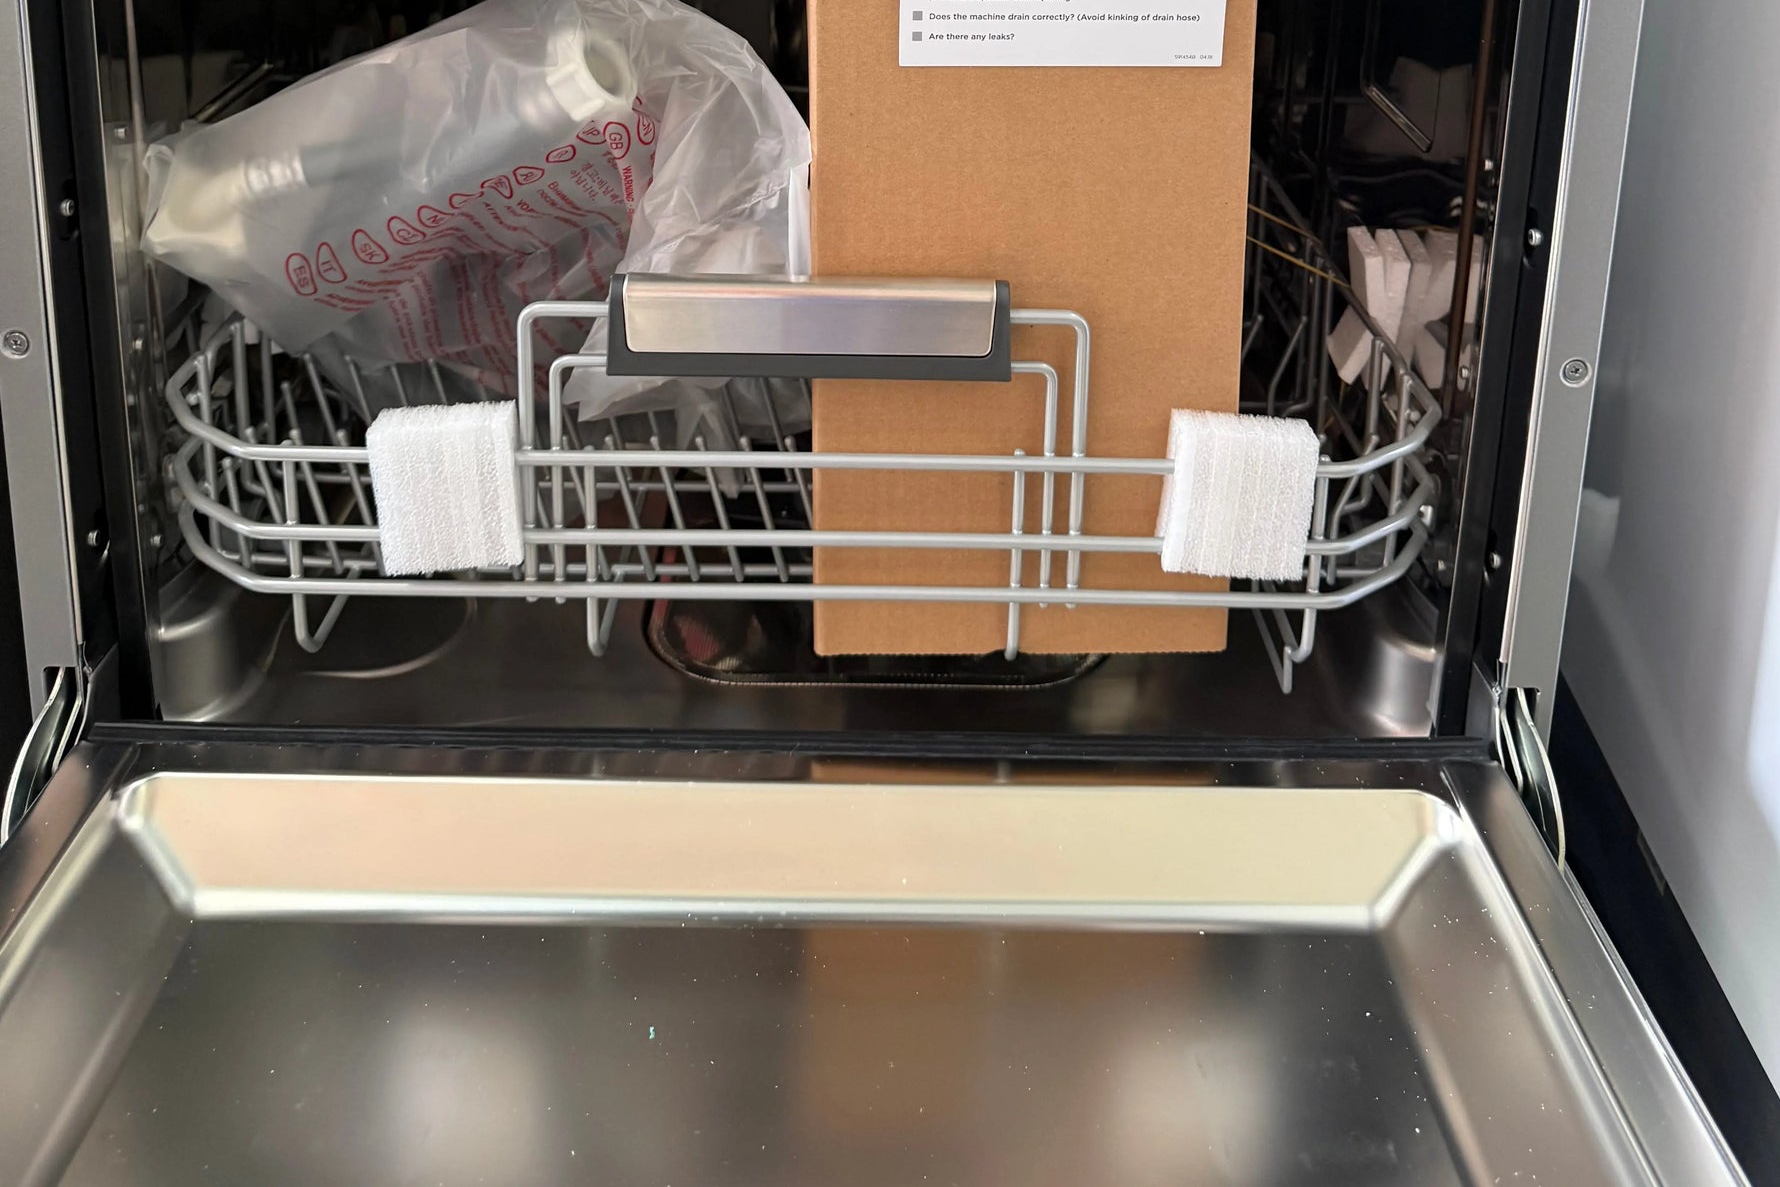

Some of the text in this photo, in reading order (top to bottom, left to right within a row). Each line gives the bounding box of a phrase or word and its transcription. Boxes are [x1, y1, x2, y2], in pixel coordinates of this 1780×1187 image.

[929, 12, 951, 20] Does
[1031, 13, 1075, 22] correctly?
[1076, 13, 1106, 21] (Avoid
[1107, 13, 1139, 22] kinking
[1140, 13, 1150, 21] of
[1152, 13, 1174, 21] drain
[1176, 13, 1200, 22] hose)
[928, 32, 944, 40] Are
[946, 32, 969, 40] there
[988, 32, 1015, 40] leaks?
[608, 132, 624, 151] GB
[622, 166, 634, 203] WARNING
[359, 242, 381, 260] SK
[320, 260, 336, 274] IT
[293, 265, 309, 289] ES
